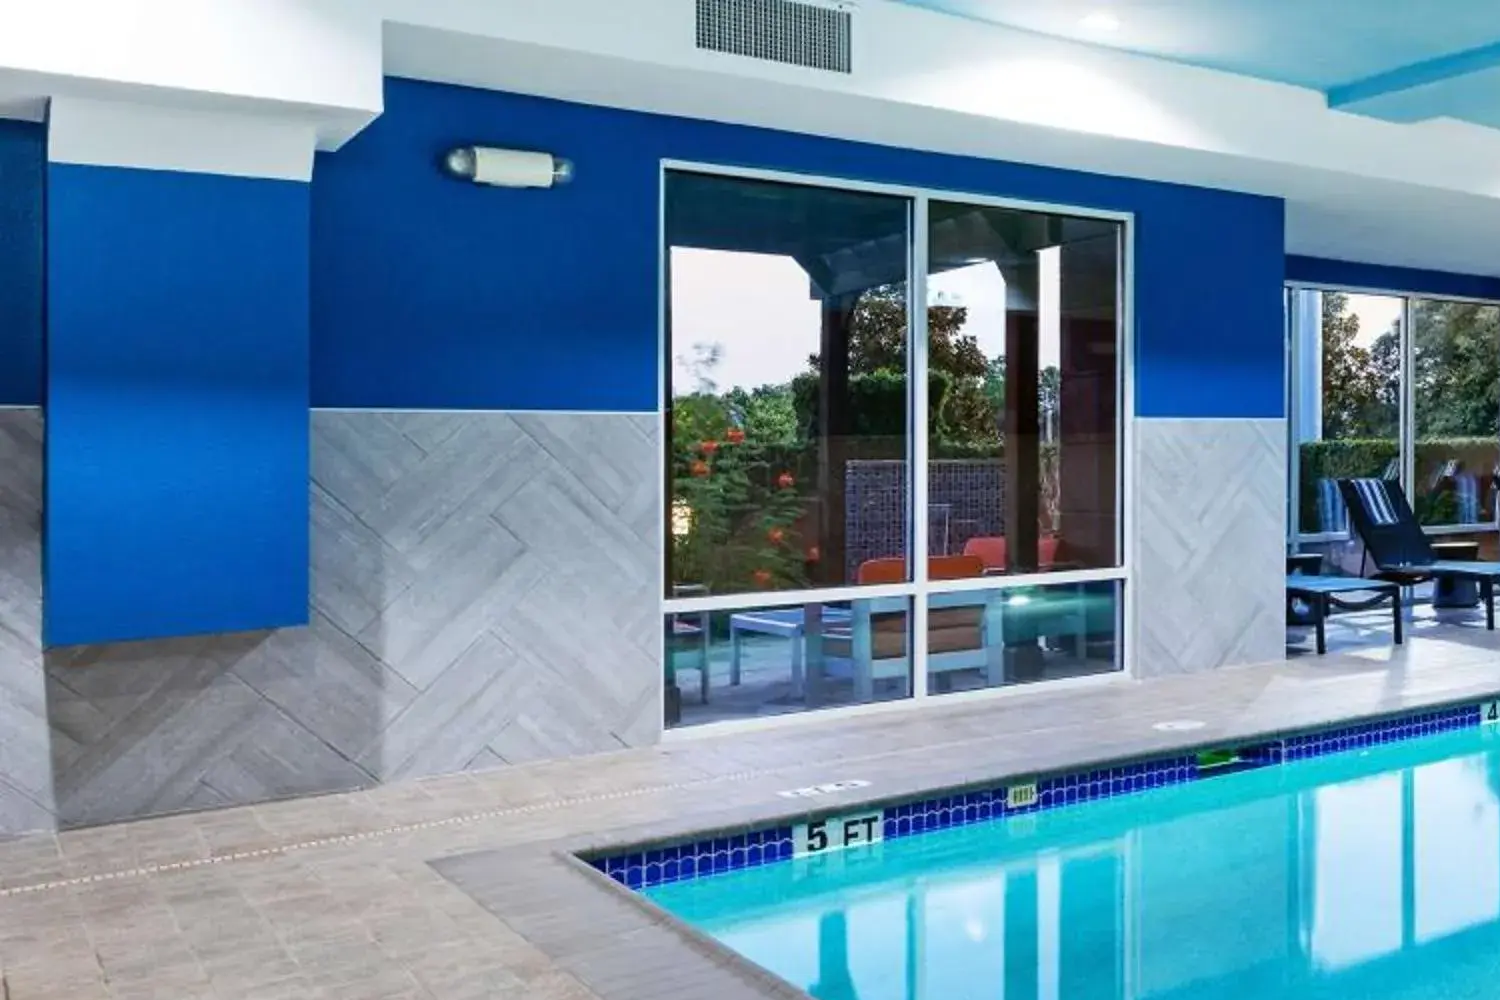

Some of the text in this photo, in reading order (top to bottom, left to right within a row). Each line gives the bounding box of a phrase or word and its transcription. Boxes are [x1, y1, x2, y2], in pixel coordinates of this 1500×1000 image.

[1487, 702, 1498, 720] 4
[807, 816, 878, 851] 5 FT
